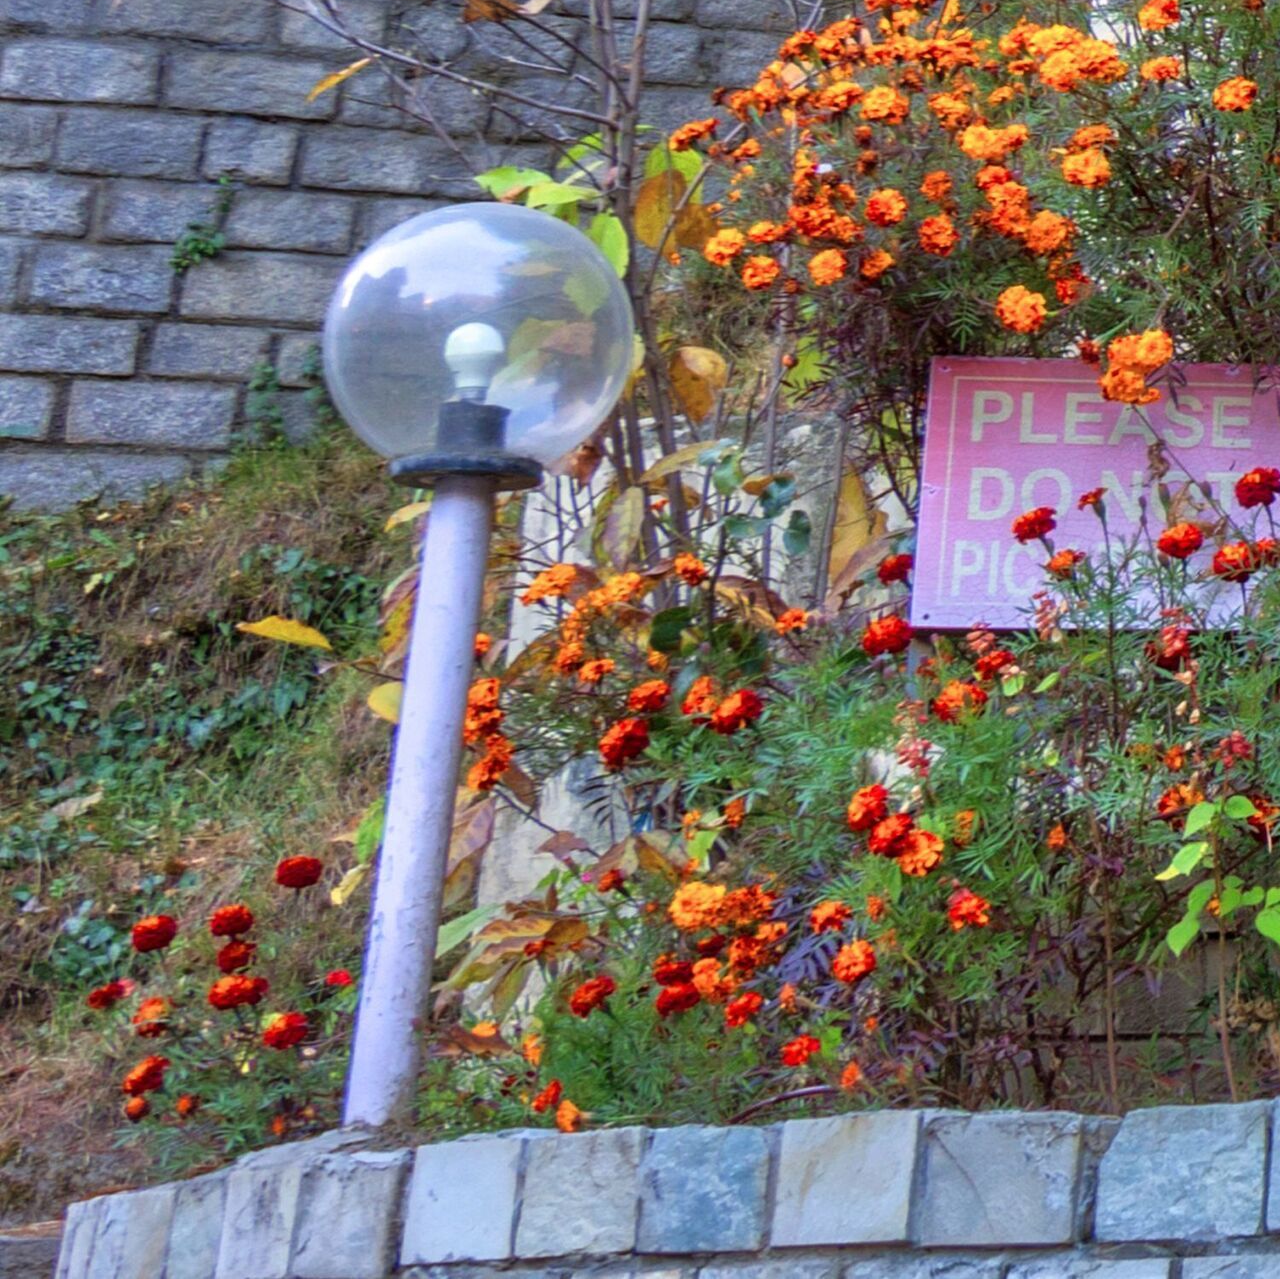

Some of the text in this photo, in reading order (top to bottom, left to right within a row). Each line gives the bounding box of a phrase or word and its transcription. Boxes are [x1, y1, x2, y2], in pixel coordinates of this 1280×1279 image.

[969, 389, 1252, 450] PLEASE
[966, 466, 1245, 528] DO NOT
[949, 539, 1056, 599] PIC
